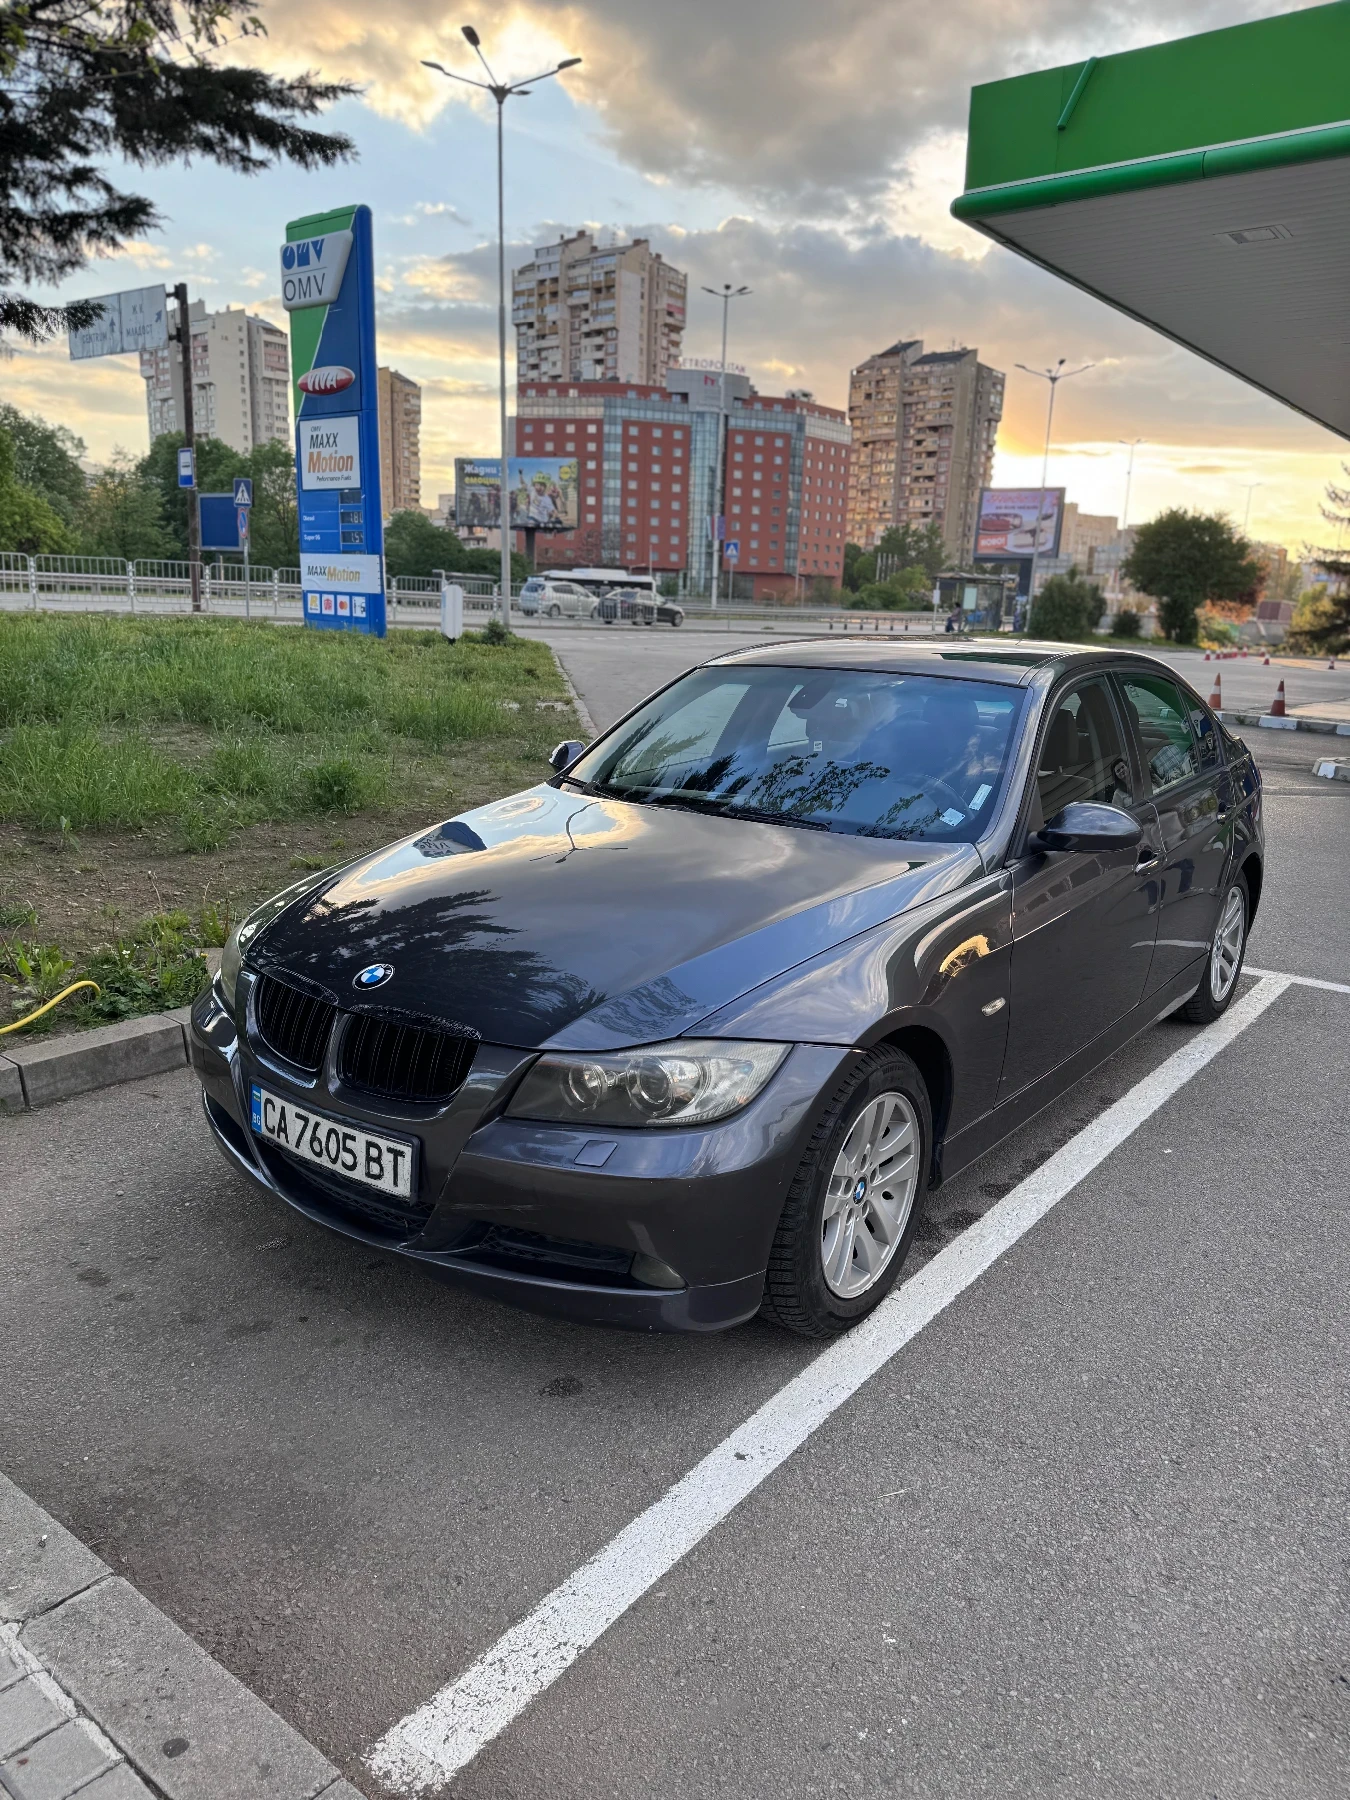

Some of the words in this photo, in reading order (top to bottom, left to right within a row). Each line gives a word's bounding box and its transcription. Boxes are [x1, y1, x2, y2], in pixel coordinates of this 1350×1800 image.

[284, 273, 325, 302] OMV
[673, 358, 745, 374] ETROPOITAN
[307, 372, 337, 391] VIVA
[310, 433, 338, 449] MAXX
[308, 450, 353, 474] Motion
[307, 566, 327, 577] MAXX
[327, 566, 360, 582] Motion
[253, 1112, 261, 1125] BG
